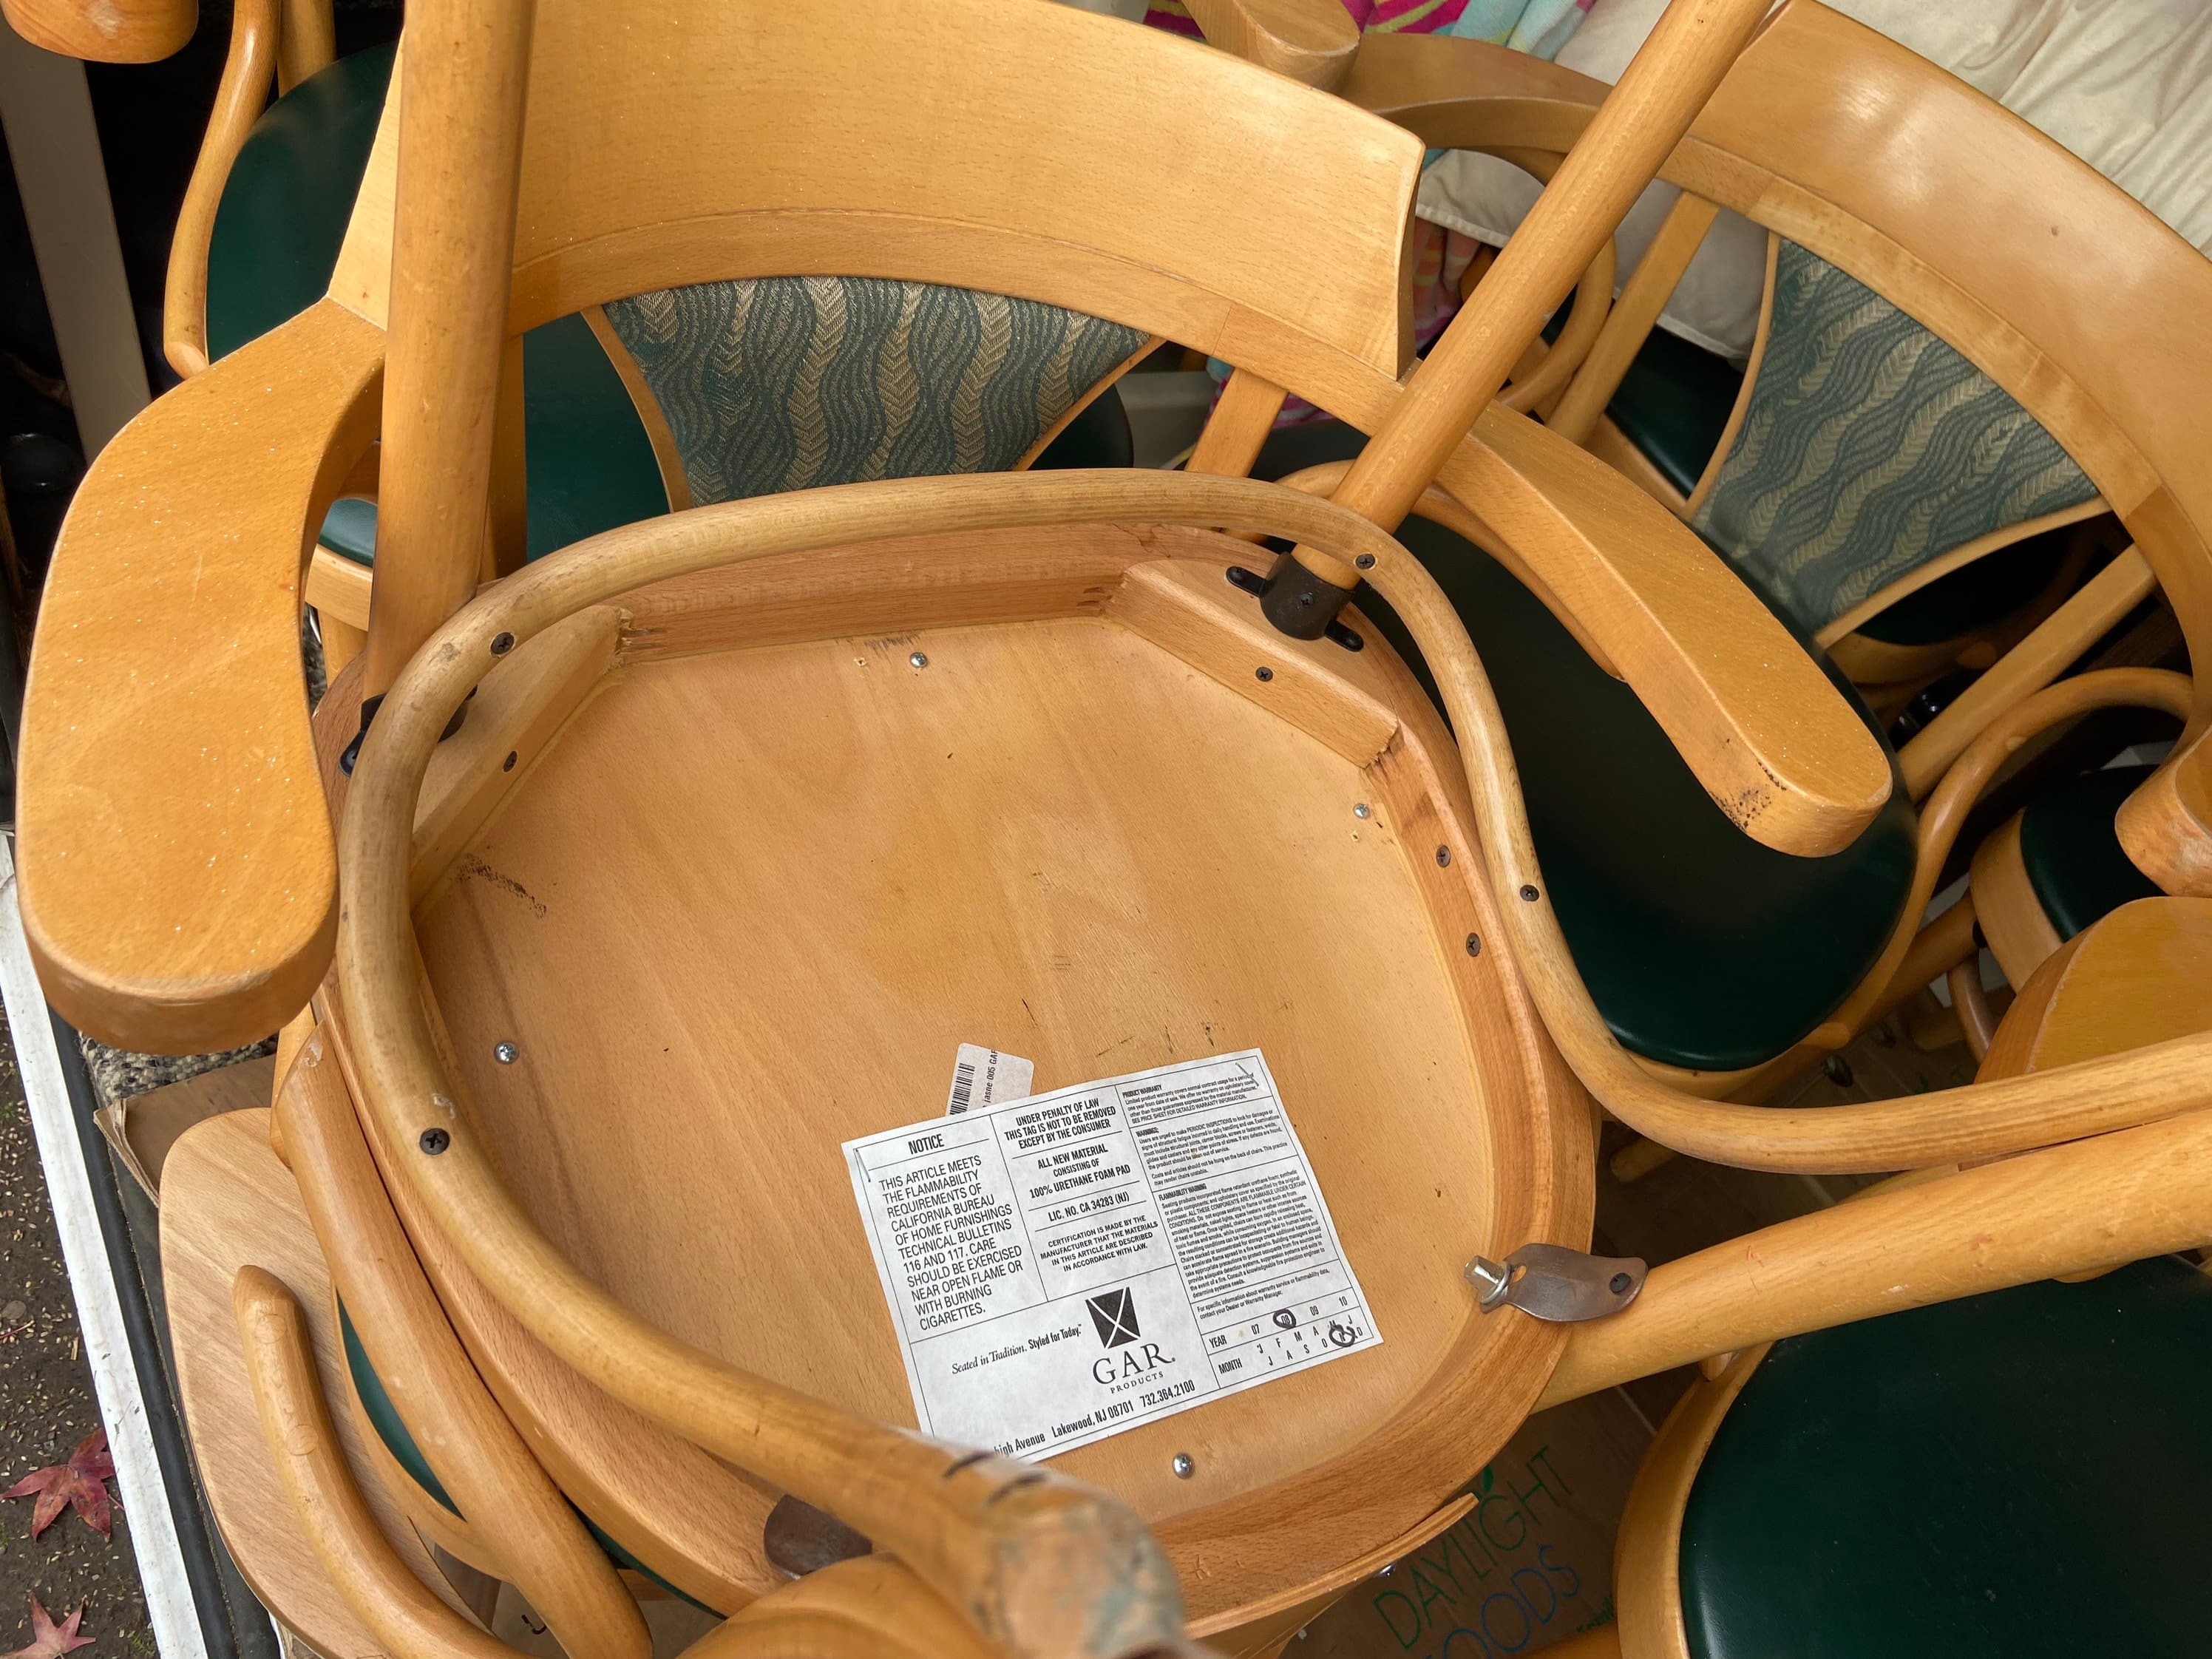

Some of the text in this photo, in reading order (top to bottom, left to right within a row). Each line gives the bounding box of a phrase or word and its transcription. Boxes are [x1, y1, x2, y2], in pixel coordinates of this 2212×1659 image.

[1004, 1105, 1116, 1141] THIS TAG IS NOT TO BE REMOVED
[1015, 1097, 1099, 1127] UNDER PENALTY OF LAW
[908, 1133, 945, 1155] NOTICE
[1018, 1119, 1111, 1150] EXCEPT BY THE CONSUMER
[878, 1155, 982, 1191] THIS ARTICLE MEETS
[1037, 1143, 1109, 1170] ALL NEW MATERIAL
[1053, 1158, 1099, 1178] CONSISTING OF
[882, 1169, 978, 1204] THE FLAMMABILITY
[1029, 1164, 1130, 1198] 100% URETHANE FOAM PAD
[886, 1182, 982, 1218] REQUIREMENTS OF
[891, 1193, 994, 1232] CALIFORNIA BUREAU
[1048, 1191, 1130, 1222] LIC. NO. CA 34283 (NJ)
[895, 1204, 1012, 1246] OF HOME FURNISHINGS
[898, 1218, 1012, 1260] TECHNICAL BULLETINS
[1040, 1221, 1158, 1260] MANUFACTURER THAT THE MATERIALS
[1048, 1229, 1096, 1248] CERTIFICATION
[1105, 1221, 1124, 1232] MADE
[1123, 1218, 1132, 1227] BY
[1133, 1215, 1147, 1224] THE
[903, 1237, 997, 1273] 116 AND 117. CARE
[1060, 1253, 1076, 1263] THIS
[1078, 1245, 1105, 1258] ARTICLE
[1105, 1241, 1119, 1250] ARE
[1118, 1232, 1153, 1246] DESCRIBED
[1073, 1251, 1116, 1269] ACCORDANCE
[1115, 1246, 1133, 1257] WITH
[1133, 1242, 1148, 1252] LAW.
[907, 1245, 1022, 1288] SHOULD BE EXERCISED
[911, 1260, 1023, 1302] NEAR OPEN FLAME OR
[915, 1284, 992, 1316] WITH BURNING
[920, 1302, 985, 1331] CIGARETTES.
[1209, 1296, 1348, 1348] YEAR 07 08 09 10
[1258, 1343, 1264, 1354] J
[1275, 1337, 1280, 1348] F
[1294, 1331, 1303, 1342] M
[1312, 1326, 1319, 1336] A
[1348, 1314, 1353, 1325] J
[952, 1356, 978, 1374] Seated
[980, 1355, 989, 1365] in
[988, 1345, 1027, 1362] Tradition.
[1028, 1334, 1050, 1349] Styled
[1050, 1332, 1060, 1343] for
[1268, 1356, 1273, 1366] J
[1286, 1350, 1293, 1360] A
[1303, 1344, 1310, 1354] S
[1321, 1338, 1328, 1348] O
[1356, 1326, 1363, 1337] D
[1110, 1371, 1164, 1394] PRODUCTS
[1218, 1357, 1243, 1374] MONTH
[1015, 1434, 1045, 1451] Avenue
[1051, 1414, 1096, 1438] Lakewood,
[1094, 1408, 1107, 1423] NJ
[1107, 1400, 1134, 1419] 08701
[1139, 1380, 1195, 1408] 732.364.2100
[1372, 1445, 1573, 1651] DAYLIGHT
[1425, 1544, 1581, 1659] OODS
